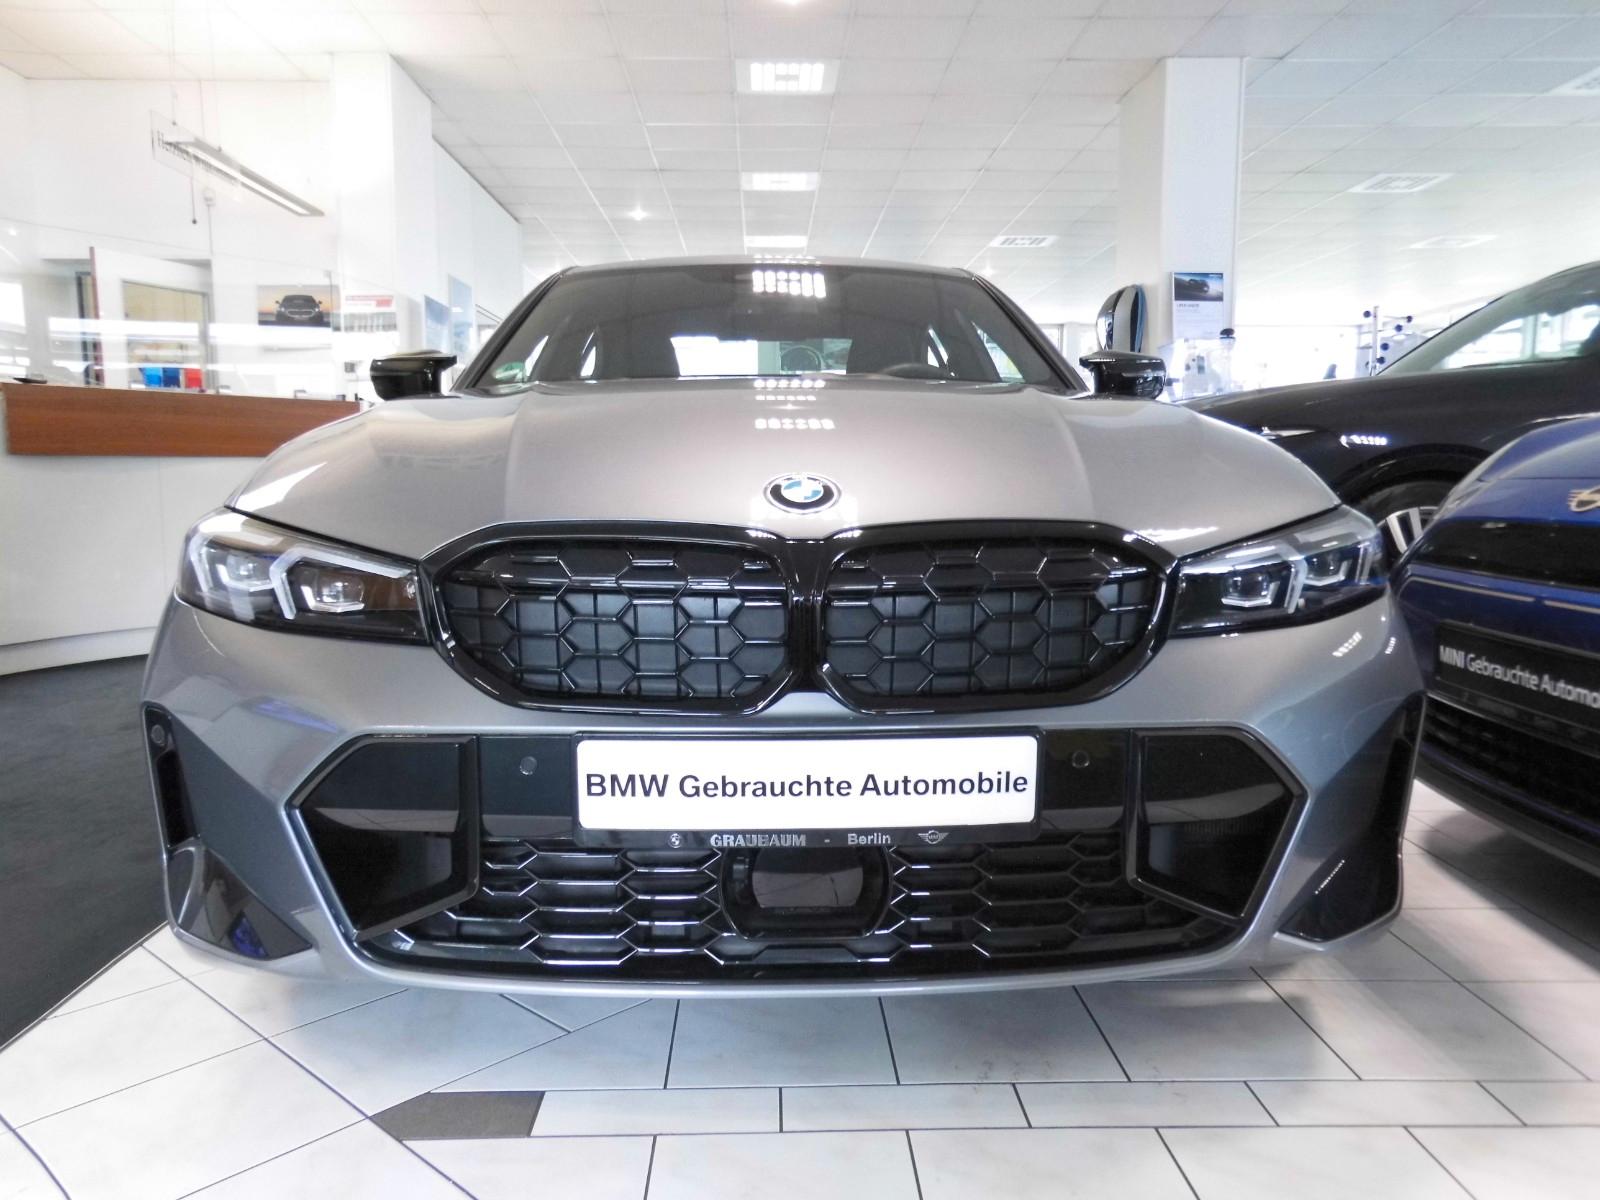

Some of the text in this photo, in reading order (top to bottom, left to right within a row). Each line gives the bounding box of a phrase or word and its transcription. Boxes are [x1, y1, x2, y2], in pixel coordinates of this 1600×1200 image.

[1439, 645, 1465, 669] MINI
[1466, 653, 1539, 690] Gebrauchte
[586, 771, 1028, 798] BMW Gebrauchte Automobile
[710, 833, 806, 847] GRAUBAUM
[847, 832, 891, 845] Berlin
